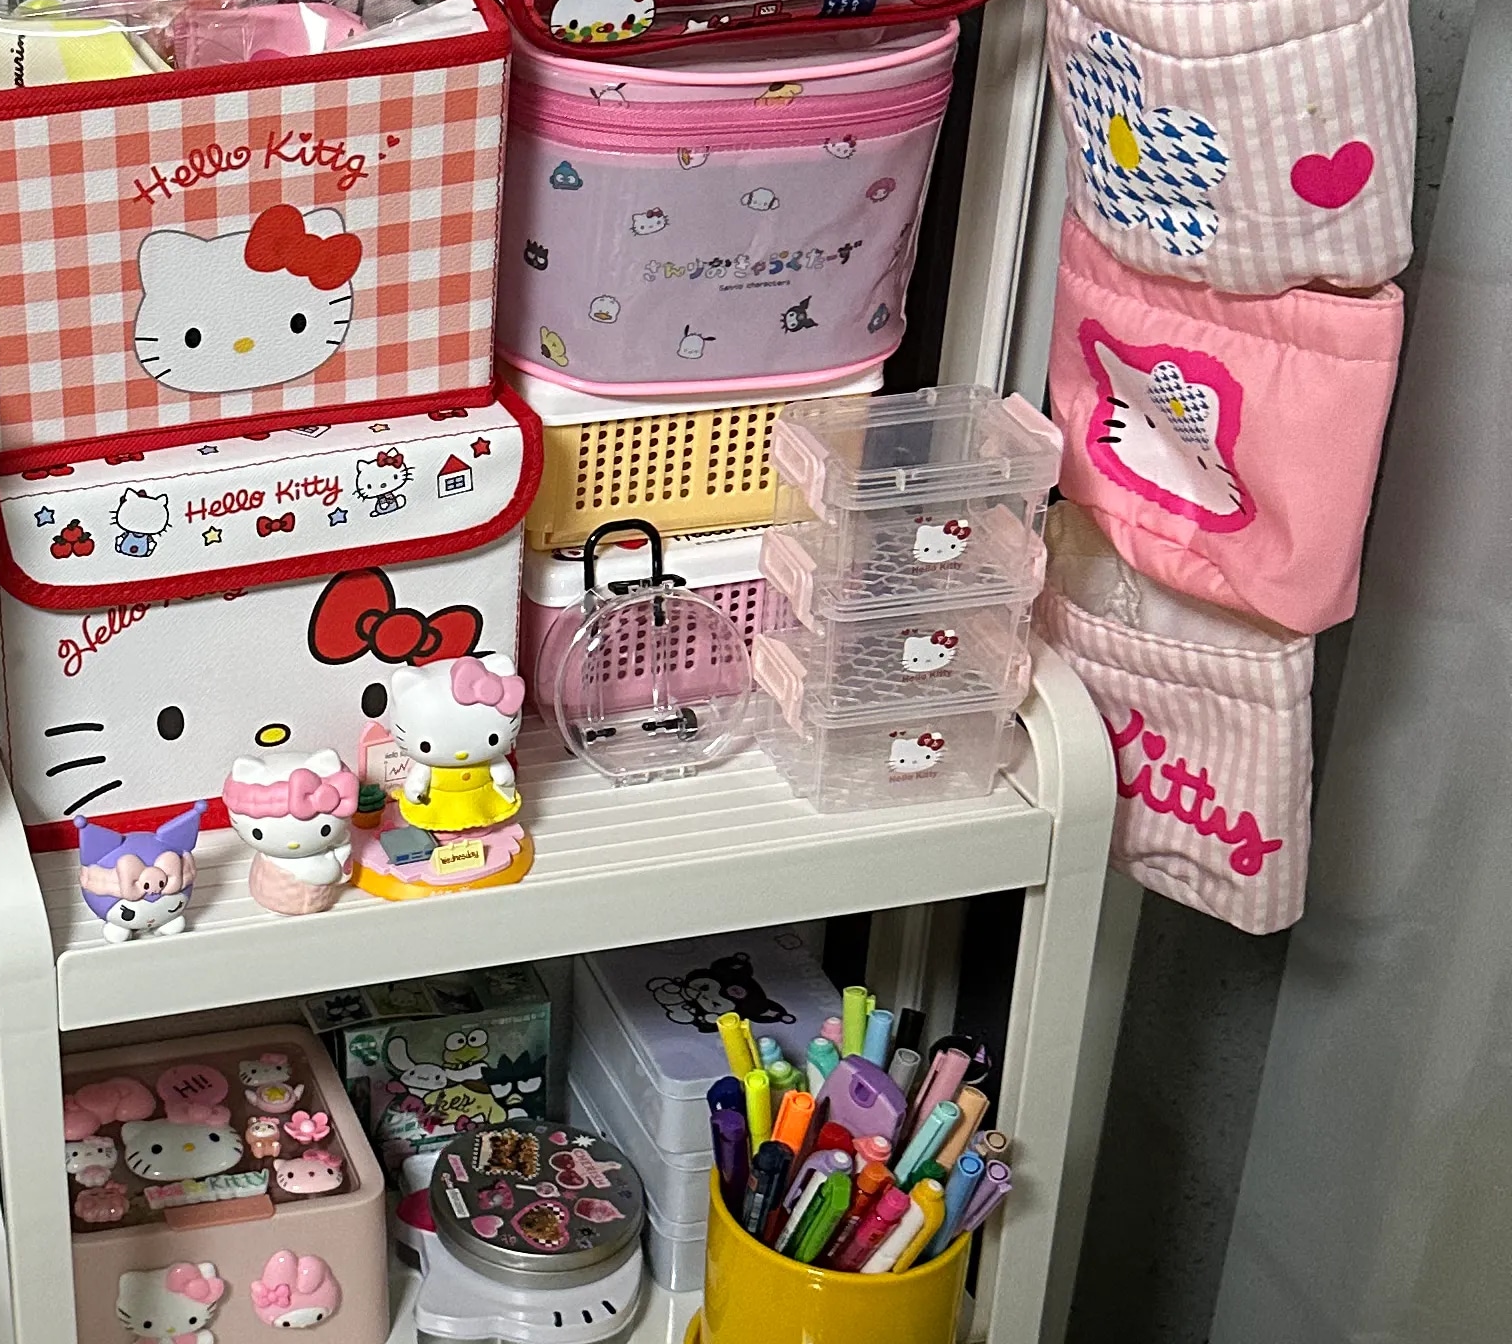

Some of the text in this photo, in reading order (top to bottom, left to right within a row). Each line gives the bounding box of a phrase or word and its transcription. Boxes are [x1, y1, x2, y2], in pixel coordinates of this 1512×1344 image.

[133, 129, 370, 207] Hello Kitty
[184, 472, 344, 525] Hello Kitty
[912, 561, 964, 575] Hello Kitty
[58, 602, 152, 677] Hello
[901, 668, 953, 683] Hello Kitty
[888, 769, 938, 783] Hello Kitty
[172, 1074, 213, 1099] HI!
